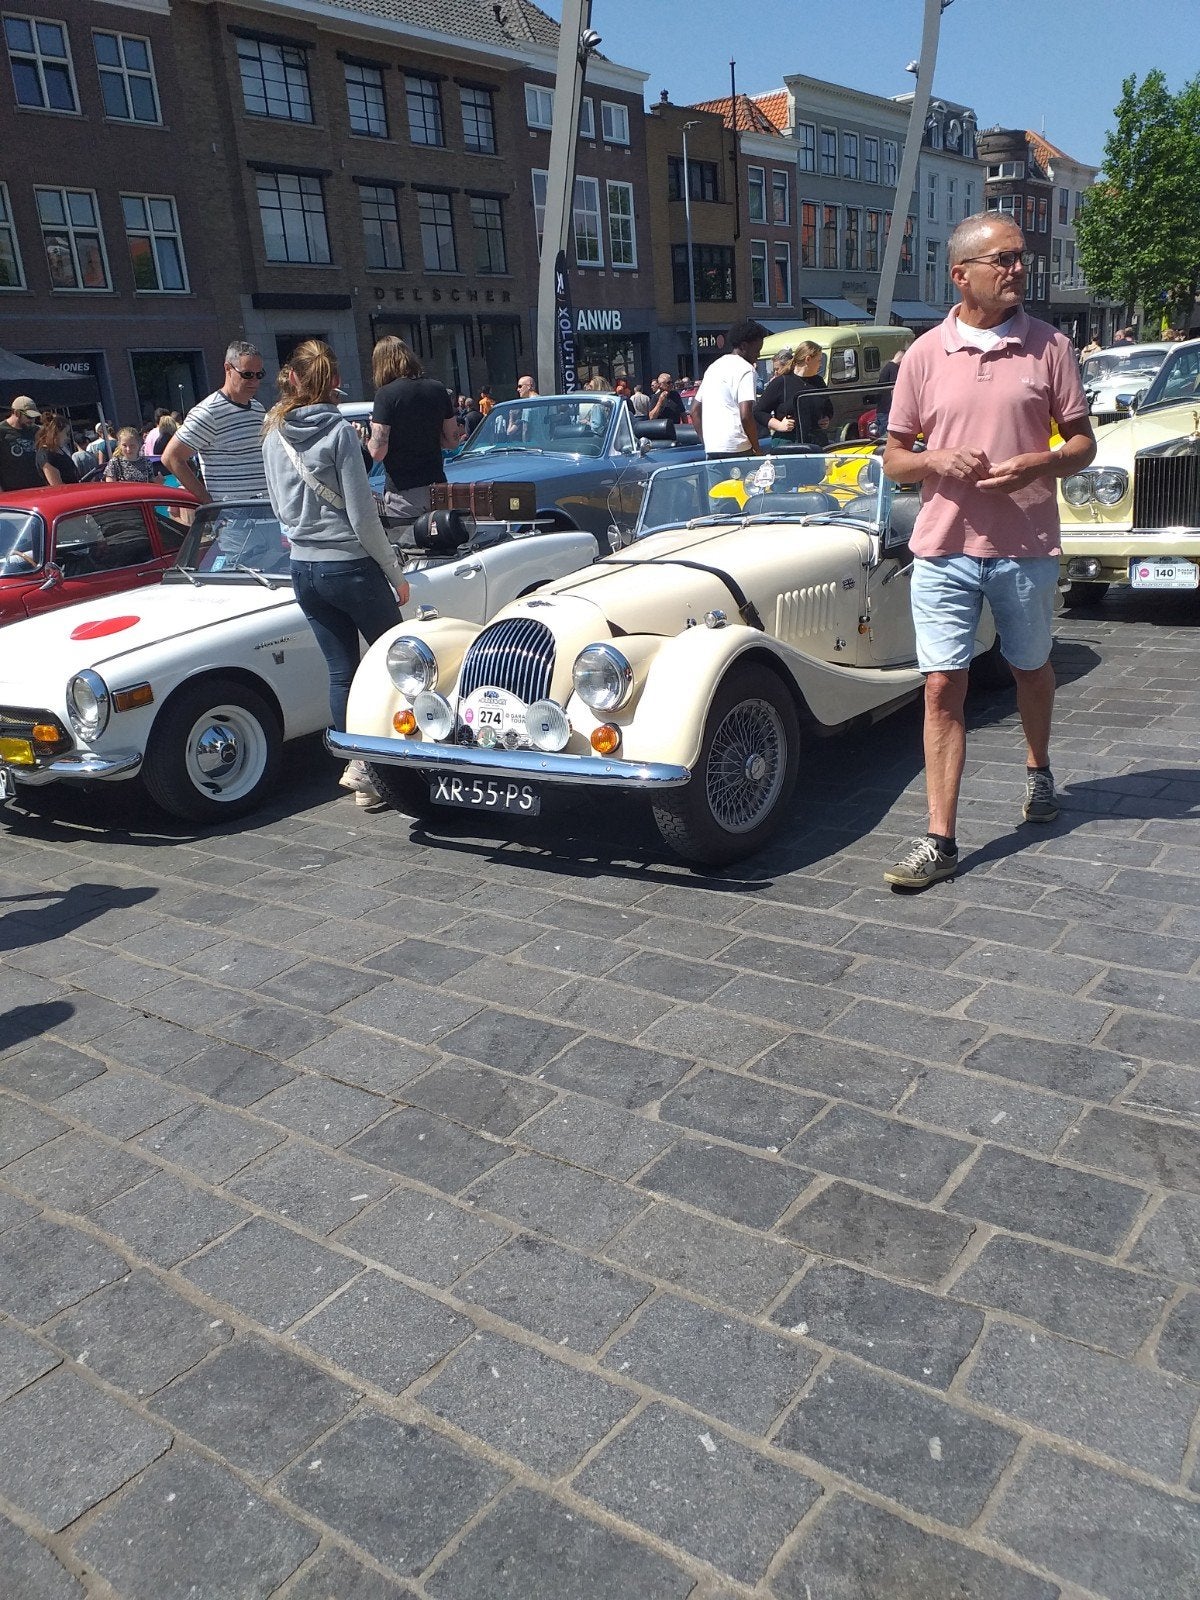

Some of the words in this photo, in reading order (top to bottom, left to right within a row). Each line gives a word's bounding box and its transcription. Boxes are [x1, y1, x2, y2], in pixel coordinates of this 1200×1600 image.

[373, 287, 511, 302] DELSCHER
[577, 309, 622, 331] ANWB
[558, 306, 576, 394] XOLUTION
[59, 362, 90, 372] JONES
[1155, 569, 1174, 577] 140
[480, 710, 502, 725] 274
[435, 776, 534, 810] XR-55-PS
